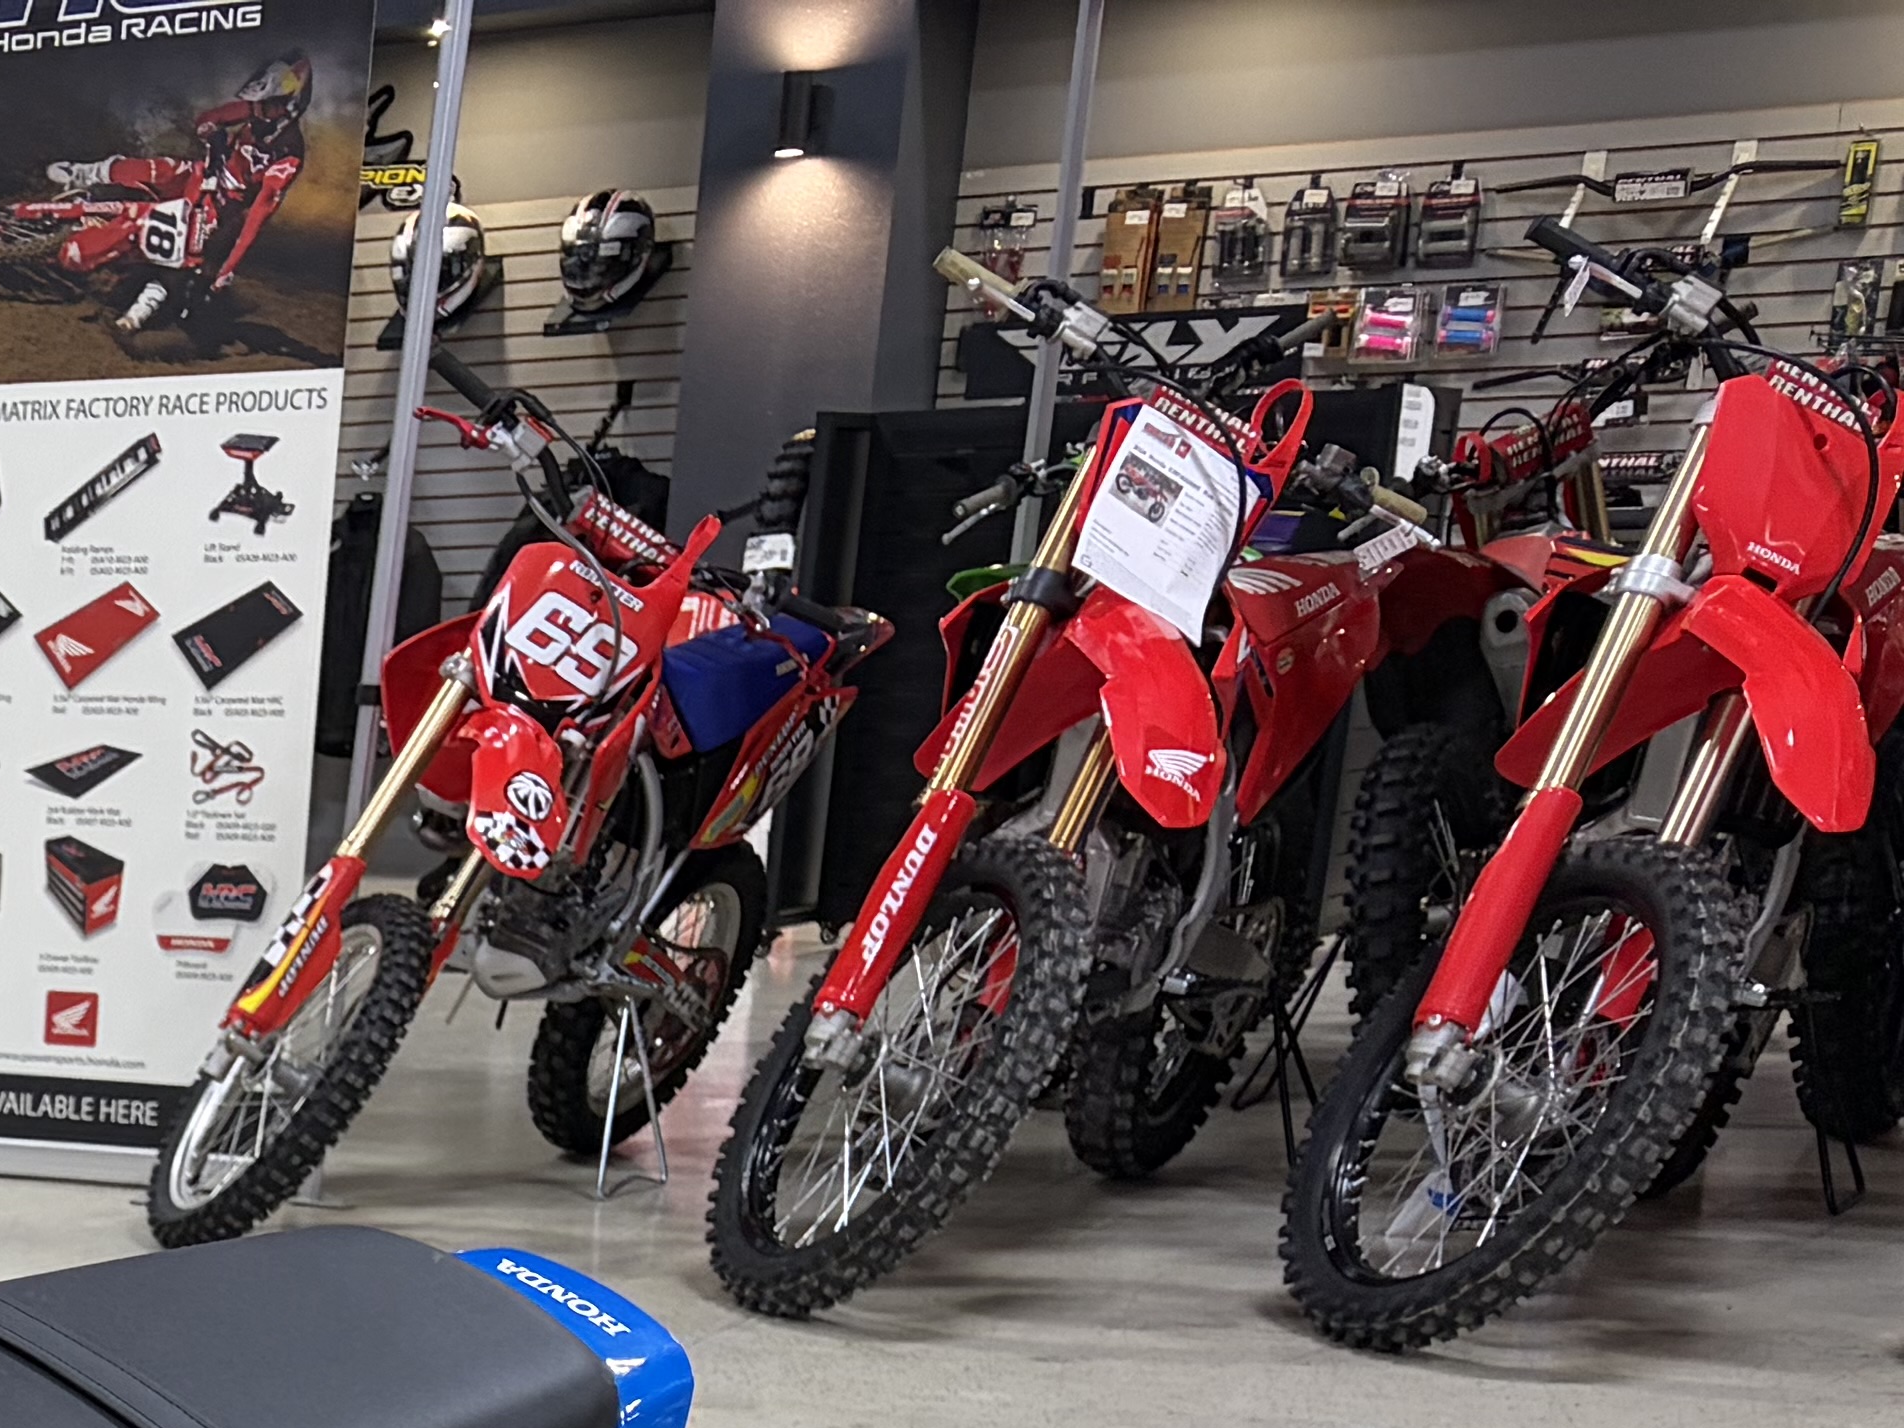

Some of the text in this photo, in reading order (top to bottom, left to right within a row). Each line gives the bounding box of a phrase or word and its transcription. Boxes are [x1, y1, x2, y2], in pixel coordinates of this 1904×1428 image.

[120, 5, 262, 40] RACING
[145, 209, 177, 260] 18
[65, 395, 154, 420] FACTORY
[158, 393, 210, 416] RACE
[215, 387, 328, 412] PRODUCTS
[1769, 374, 1877, 432] RENTHA
[204, 555, 223, 563] Black
[1747, 541, 1801, 576] HONDA
[1295, 582, 1341, 618] HONDA
[505, 590, 638, 697] 69
[1145, 764, 1201, 802] HONDA
[861, 822, 938, 962] DUNLOP
[278, 915, 329, 998] DUNLOP
[99, 1098, 159, 1127] HERE
[496, 1258, 632, 1337] HONDA
